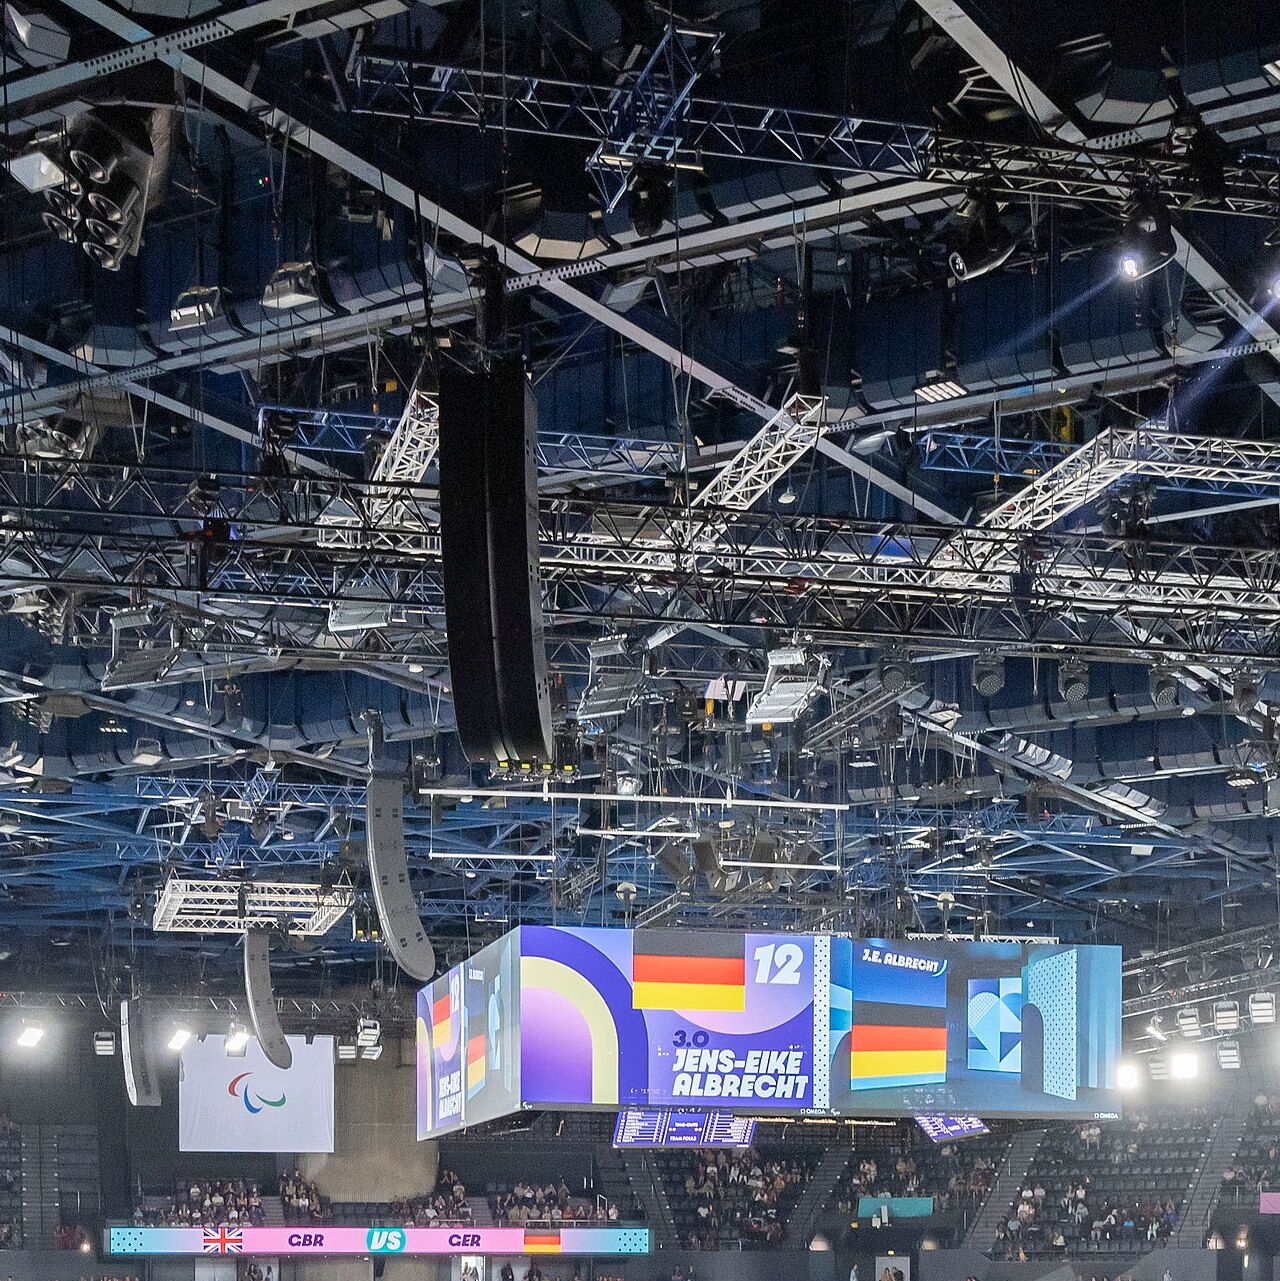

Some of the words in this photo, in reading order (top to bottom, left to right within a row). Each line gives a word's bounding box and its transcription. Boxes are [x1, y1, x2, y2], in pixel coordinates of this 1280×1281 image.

[754, 942, 804, 985] 12
[862, 948, 882, 963] J.E.
[884, 954, 938, 973] ALBRECHT
[672, 1030, 709, 1047] 3.0
[672, 1049, 804, 1074] JENS-EIKE
[672, 1074, 809, 1099] ALBRECHT
[288, 1234, 324, 1247] GBR
[370, 1230, 402, 1251] VS
[448, 1235, 481, 1247] GER
